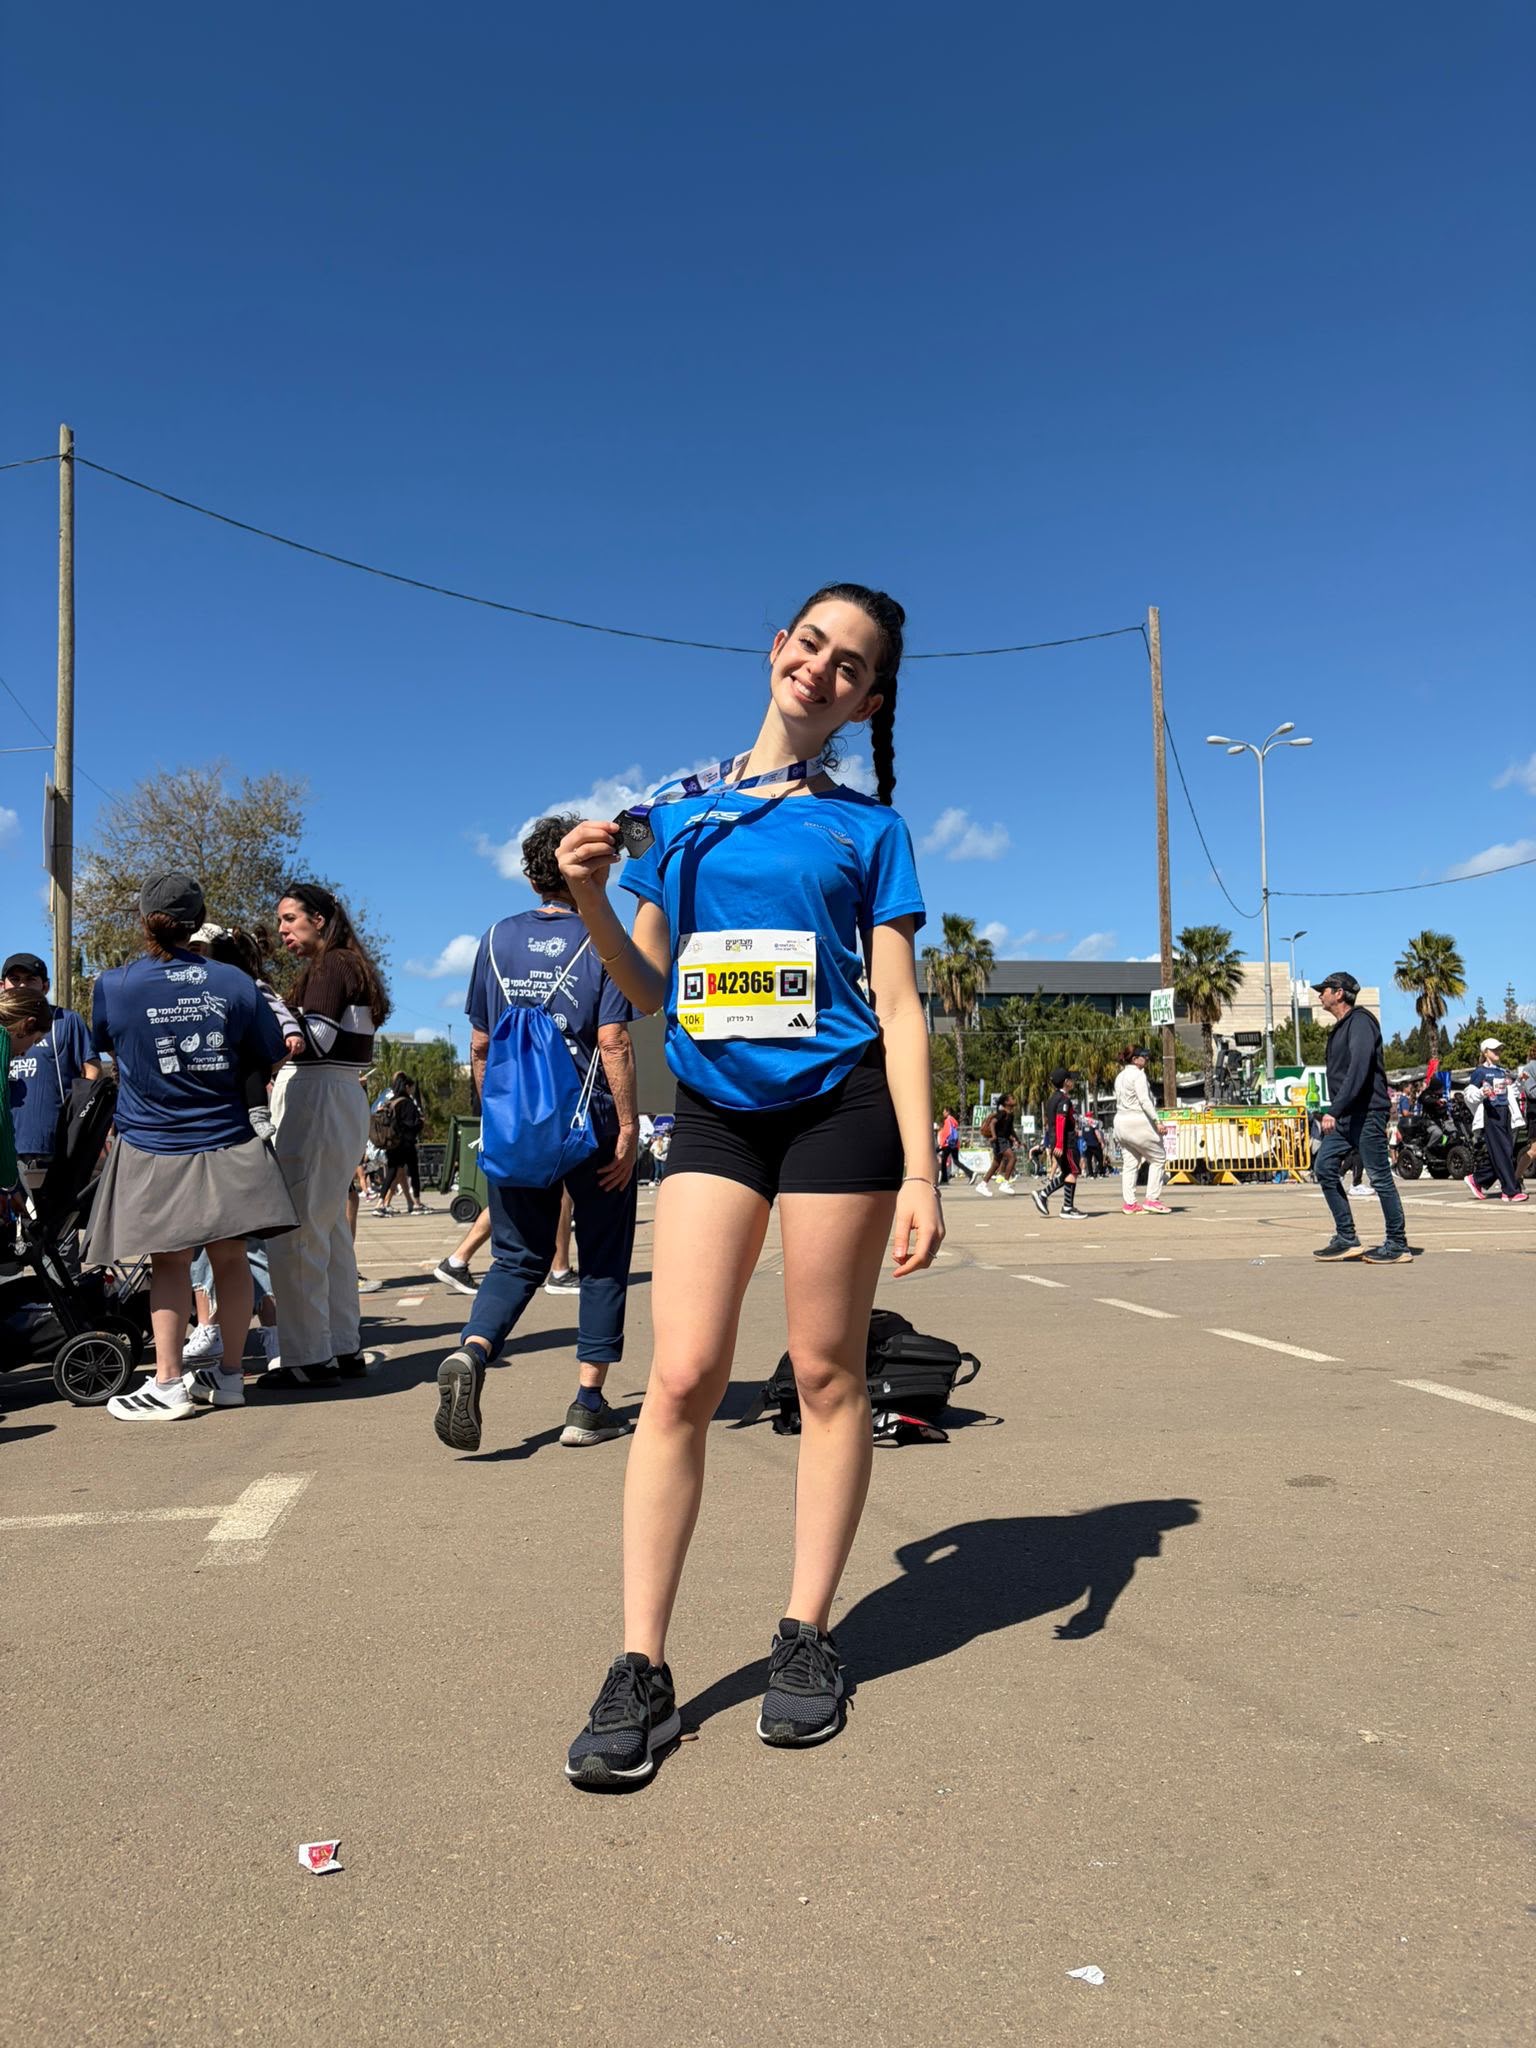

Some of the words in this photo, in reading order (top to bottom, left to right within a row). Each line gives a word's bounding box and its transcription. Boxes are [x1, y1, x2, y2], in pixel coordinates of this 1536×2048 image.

[530, 970, 553, 979] מרתון
[511, 979, 533, 988] לאומי
[533, 980, 547, 989] בנק
[707, 971, 775, 995] B42365
[177, 997, 202, 1006] מרתון
[158, 1006, 182, 1015] לאומי
[183, 1006, 198, 1015] בנק
[150, 1017, 170, 1025] 2026
[206, 1032, 224, 1048] MG
